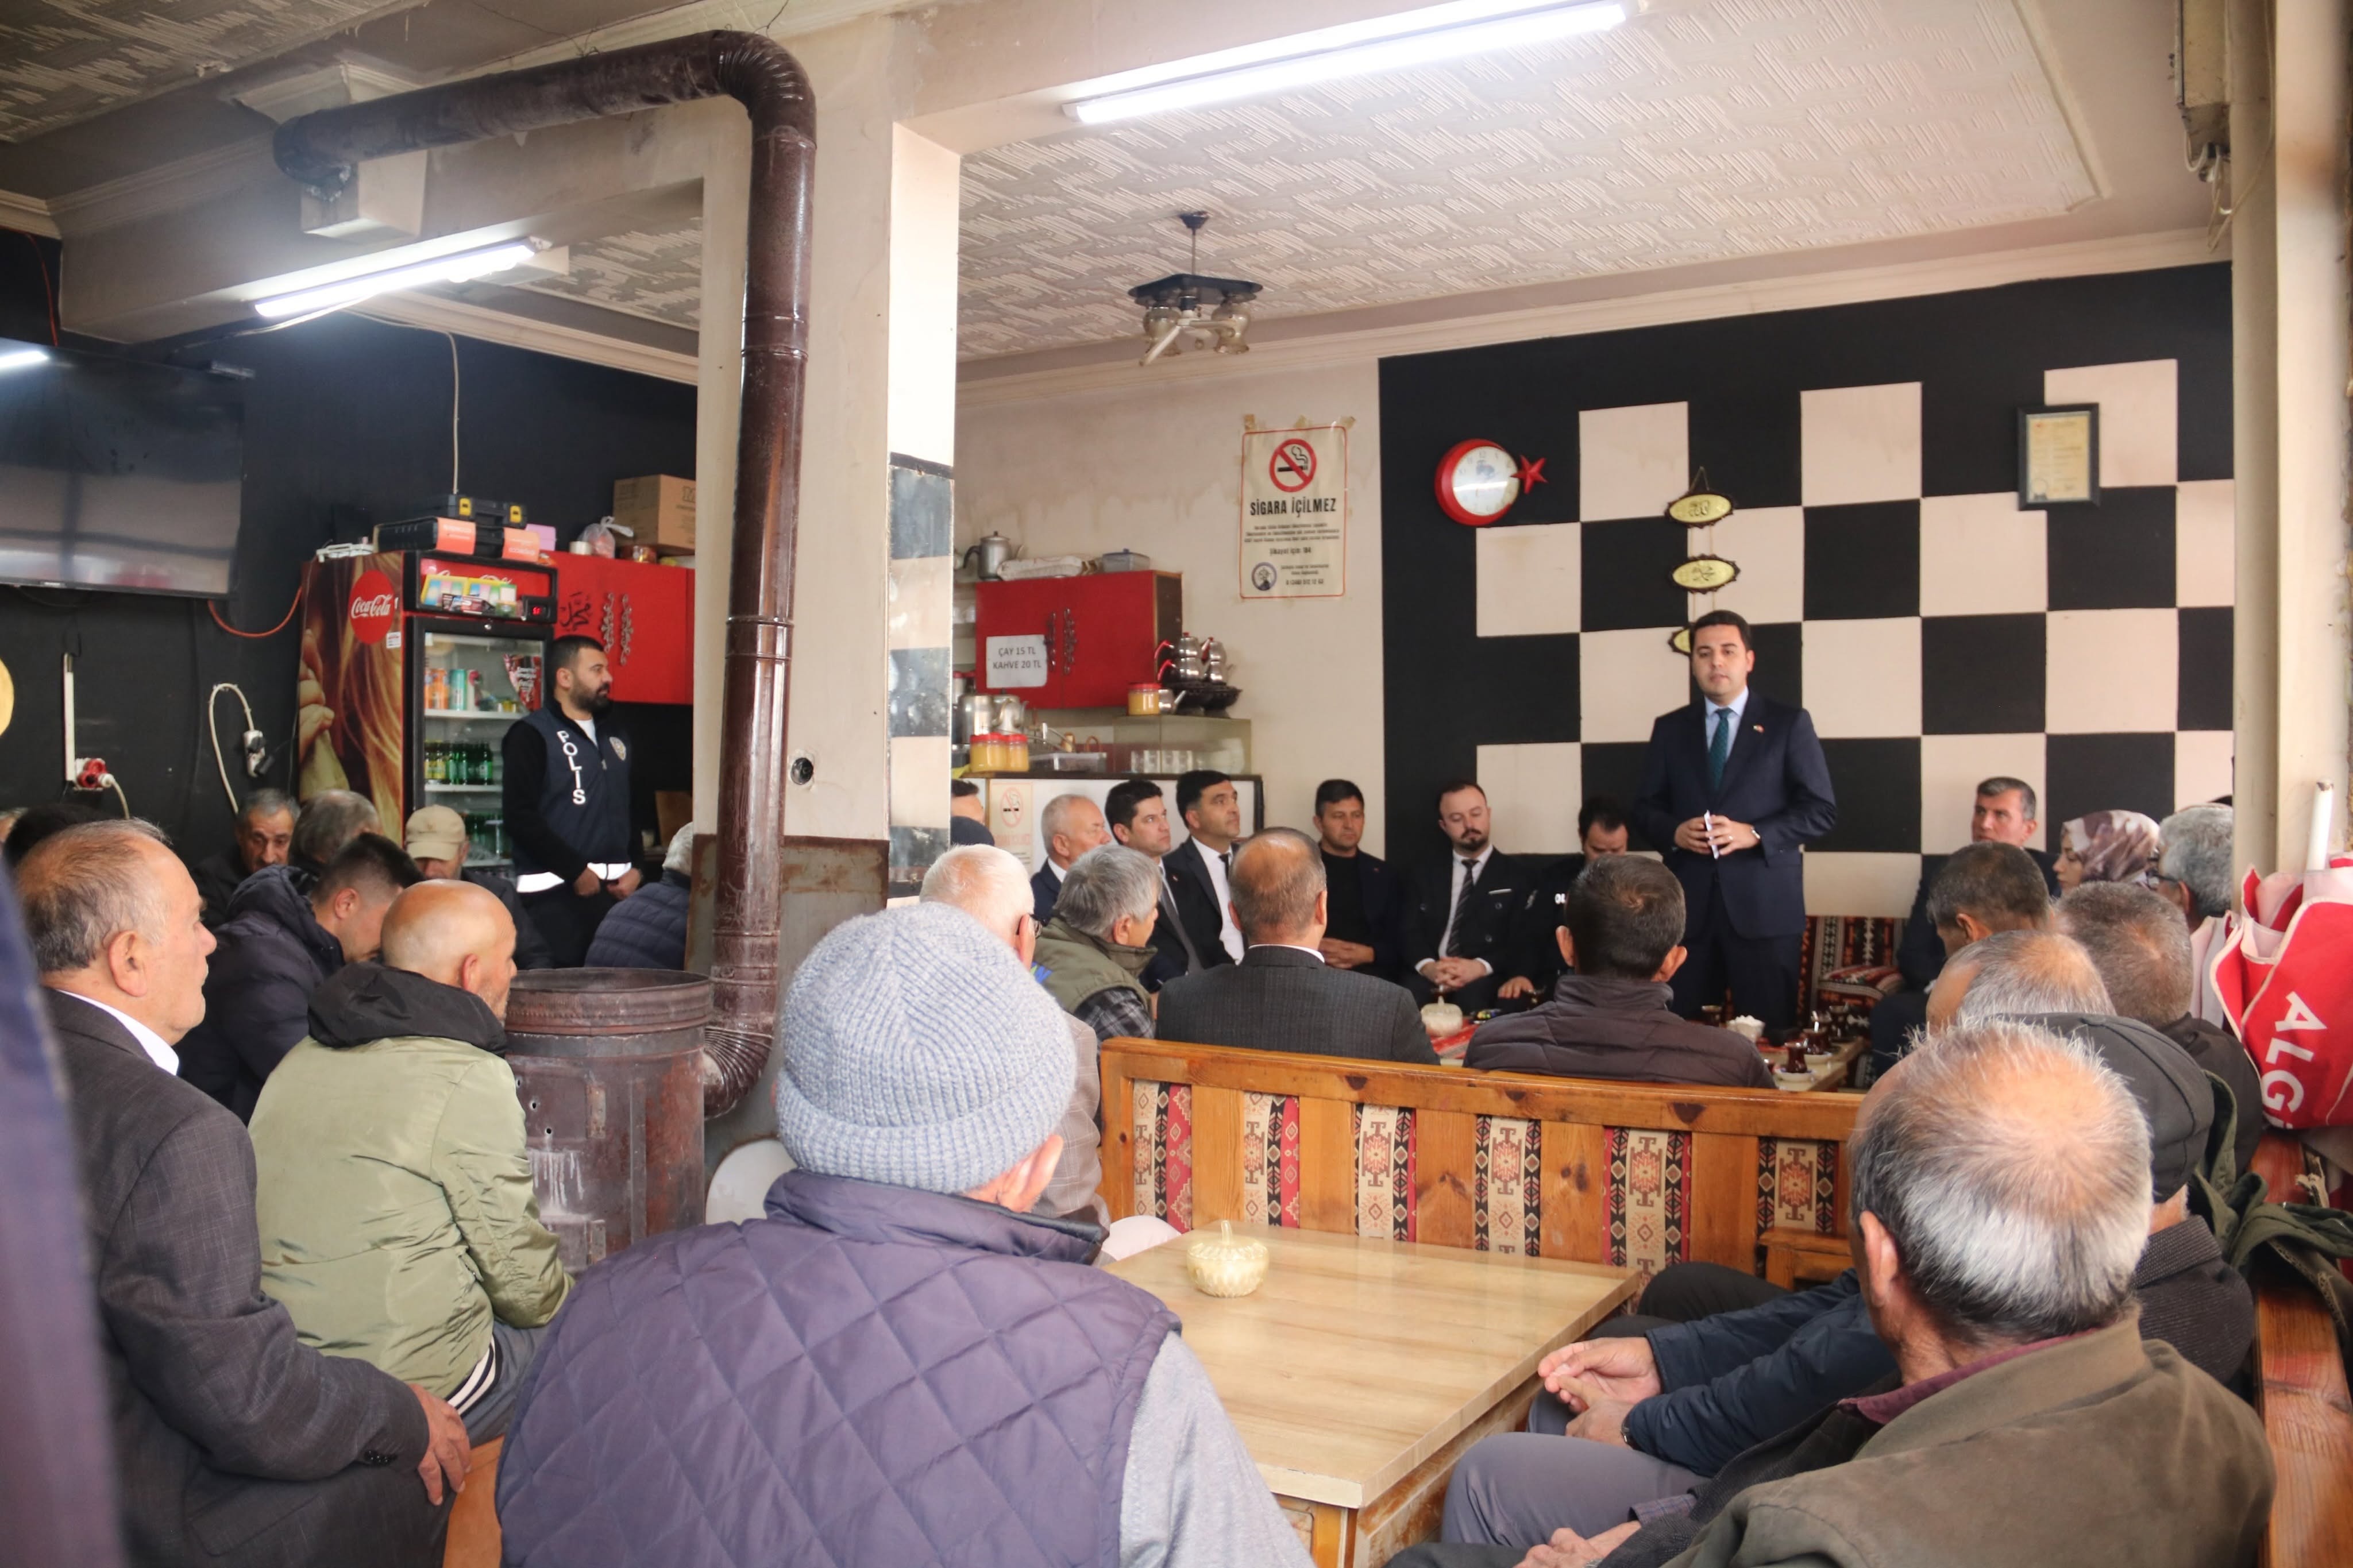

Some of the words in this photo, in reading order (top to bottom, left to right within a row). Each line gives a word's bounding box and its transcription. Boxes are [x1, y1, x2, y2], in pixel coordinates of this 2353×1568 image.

[1250, 499, 1287, 516] SİGARA
[1291, 496, 1336, 518] İÇİLMEZ
[998, 647, 1013, 658] ÇAY
[1016, 647, 1025, 655] 15
[1027, 646, 1036, 655] TL
[993, 661, 1019, 670] KAHVE
[1021, 660, 1031, 669] 20
[1033, 659, 1042, 668] TL
